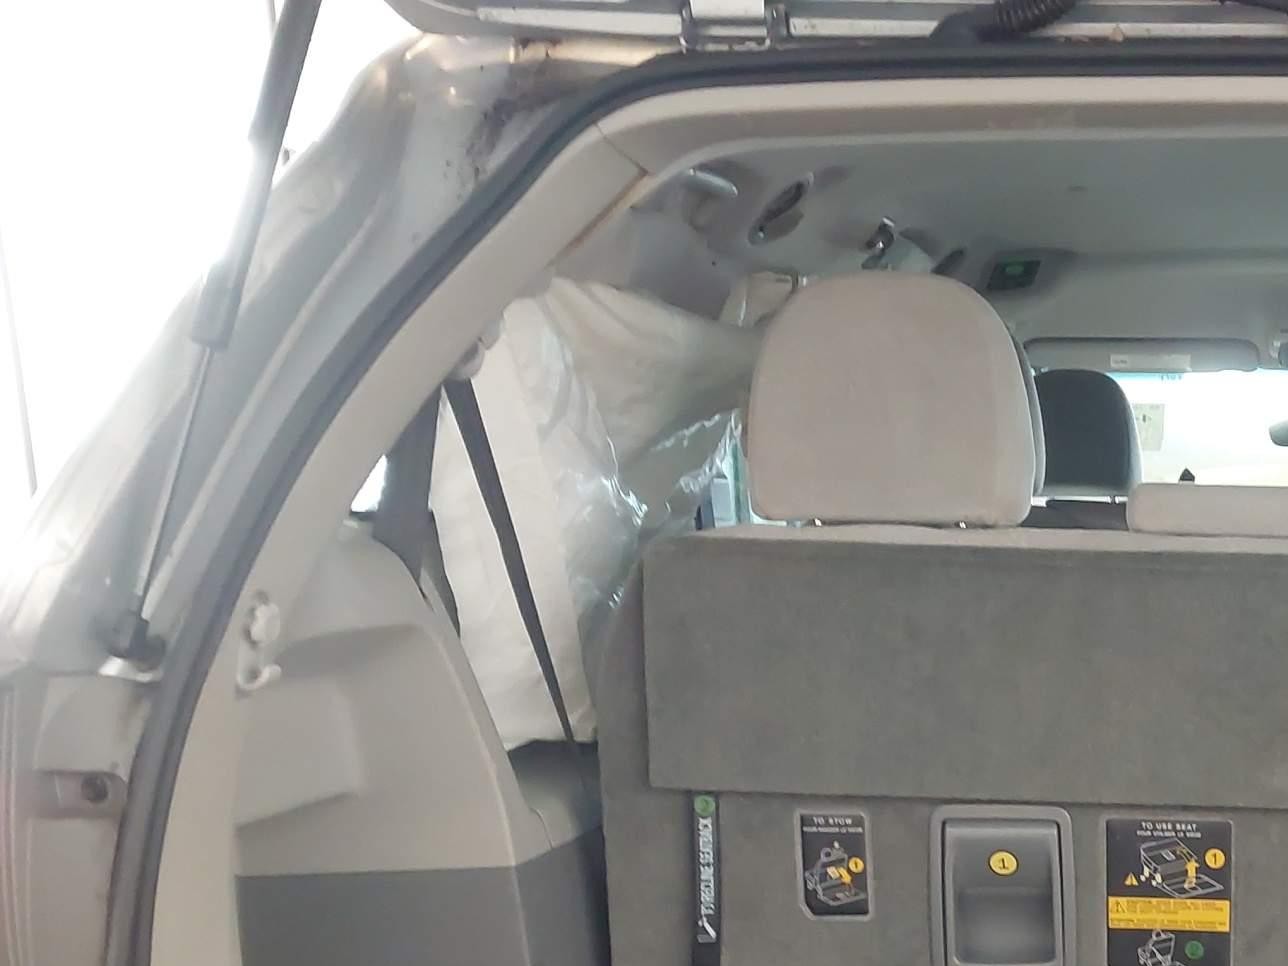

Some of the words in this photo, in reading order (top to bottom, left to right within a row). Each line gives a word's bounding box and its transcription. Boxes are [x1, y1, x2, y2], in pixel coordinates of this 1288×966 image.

[1141, 822, 1153, 830] TO
[1156, 822, 1172, 830] USE
[1175, 823, 1197, 831] SEAT
